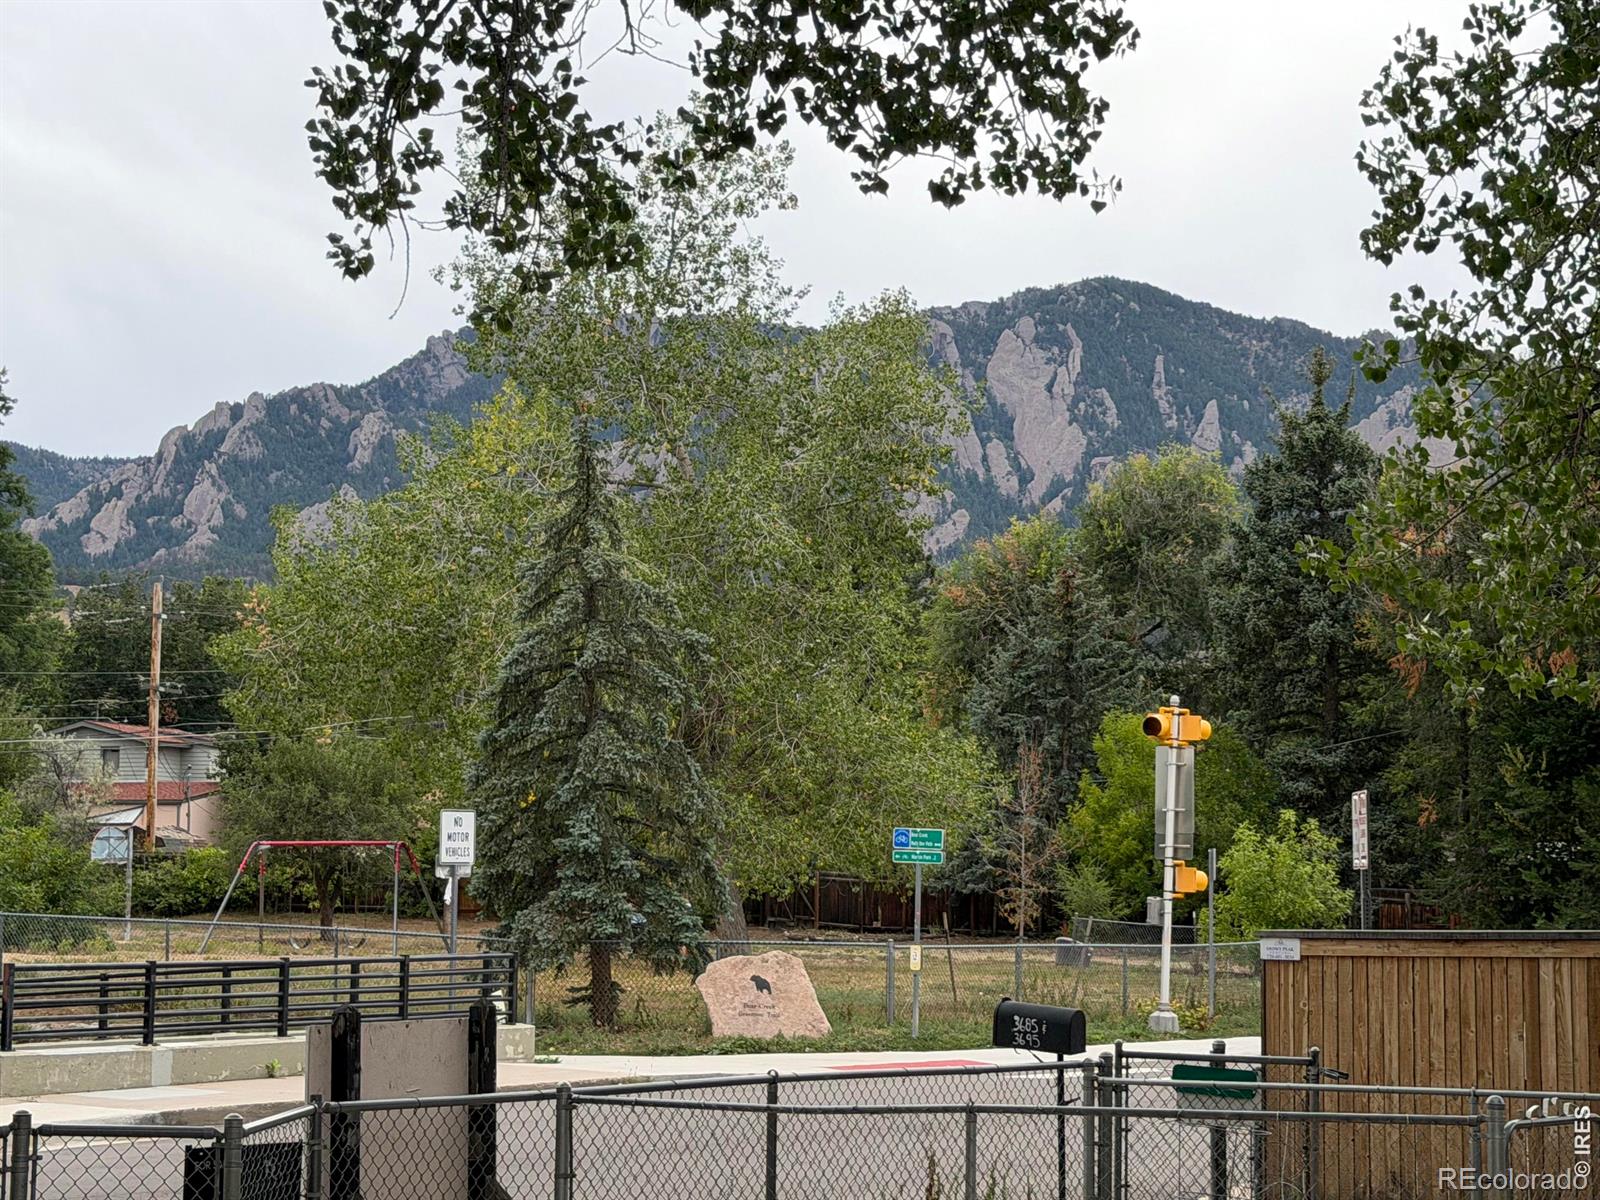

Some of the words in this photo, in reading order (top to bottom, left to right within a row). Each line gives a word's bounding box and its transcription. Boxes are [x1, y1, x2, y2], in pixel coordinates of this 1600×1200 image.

[454, 816, 463, 828] NO
[447, 832, 469, 842] MOTOR
[445, 847, 470, 857] VEHICLES
[1012, 1015, 1039, 1033] 3685
[1012, 1032, 1041, 1048] 3695
